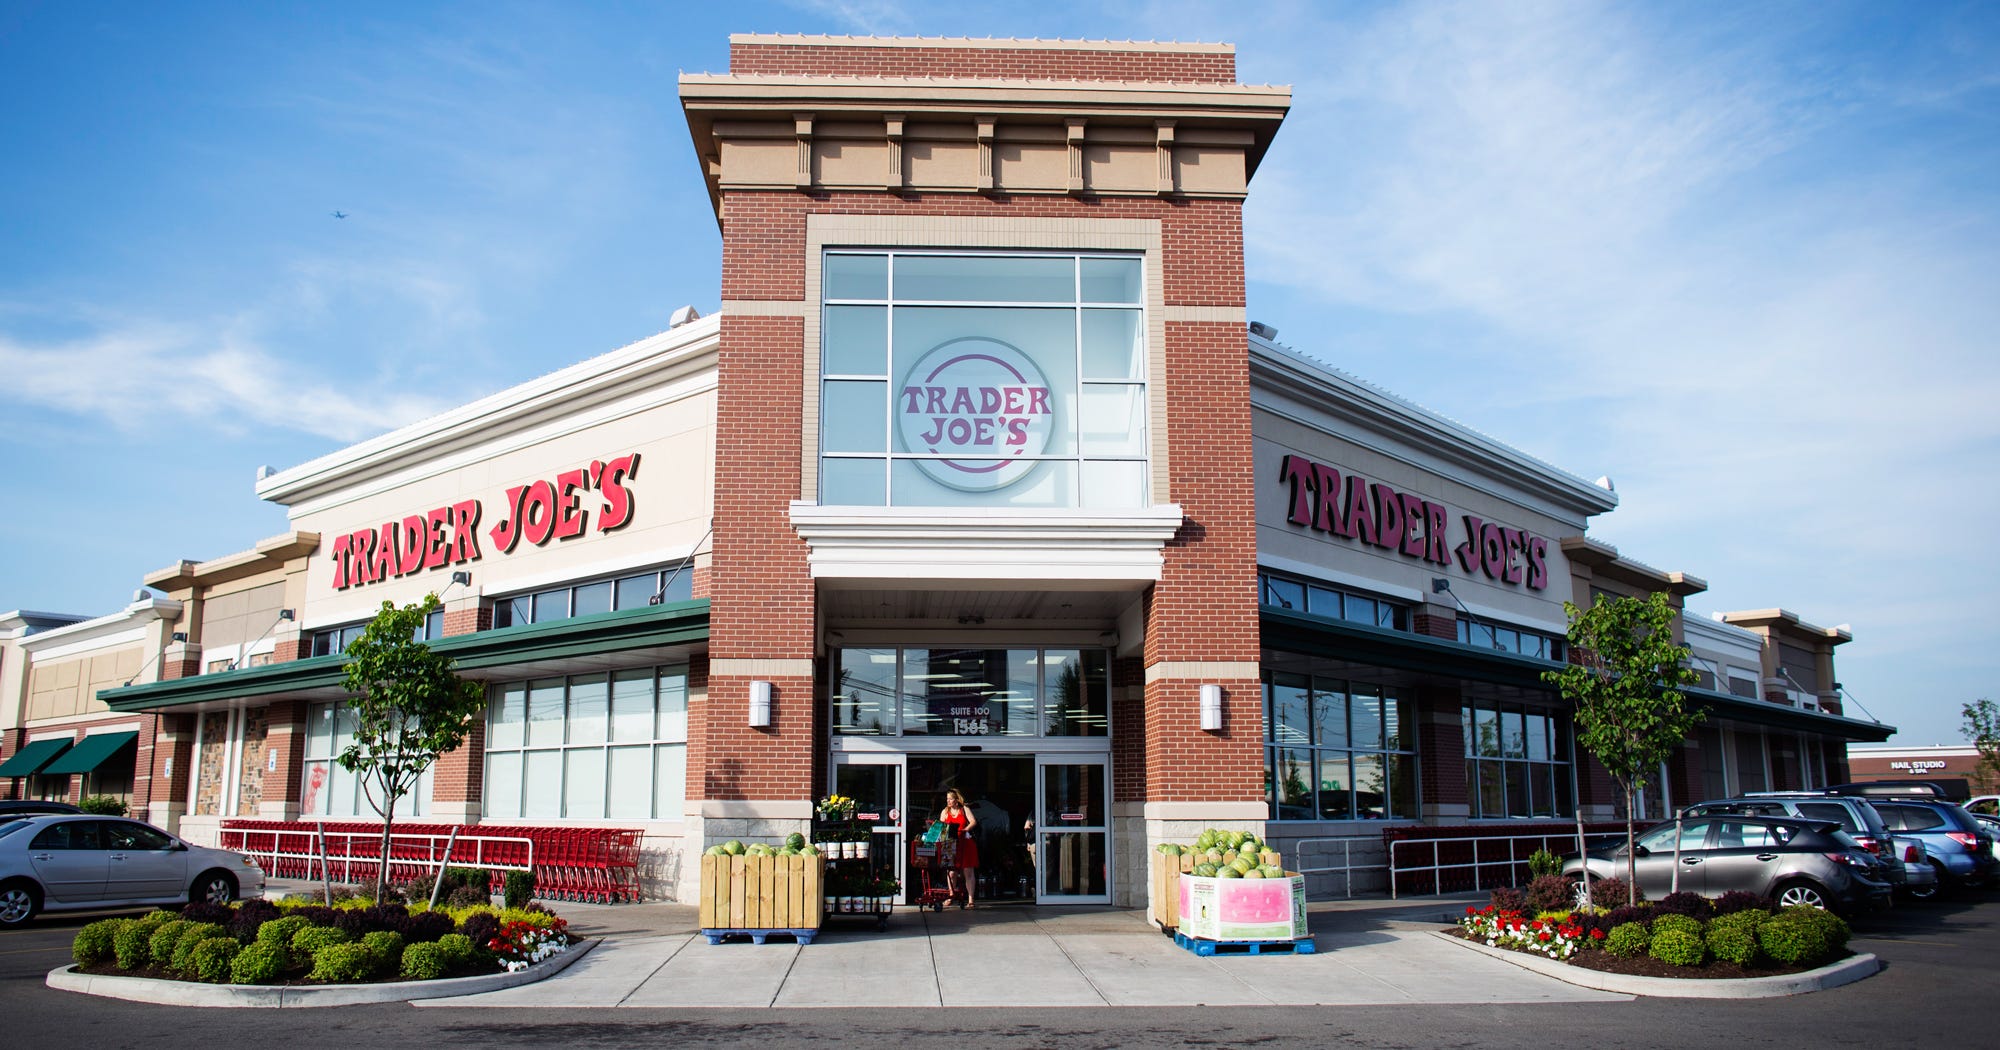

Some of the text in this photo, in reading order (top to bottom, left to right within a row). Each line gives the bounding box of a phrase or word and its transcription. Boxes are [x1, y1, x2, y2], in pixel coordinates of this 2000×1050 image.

[901, 386, 1052, 415] TRADER
[920, 416, 1031, 446] JOE'S
[332, 453, 641, 592] TRADER JOE'S
[1279, 454, 1548, 590] TRADER JOE'S
[950, 707, 989, 715] SUITE 100
[953, 718, 989, 735] 1565
[1912, 761, 1946, 769] STUDIO
